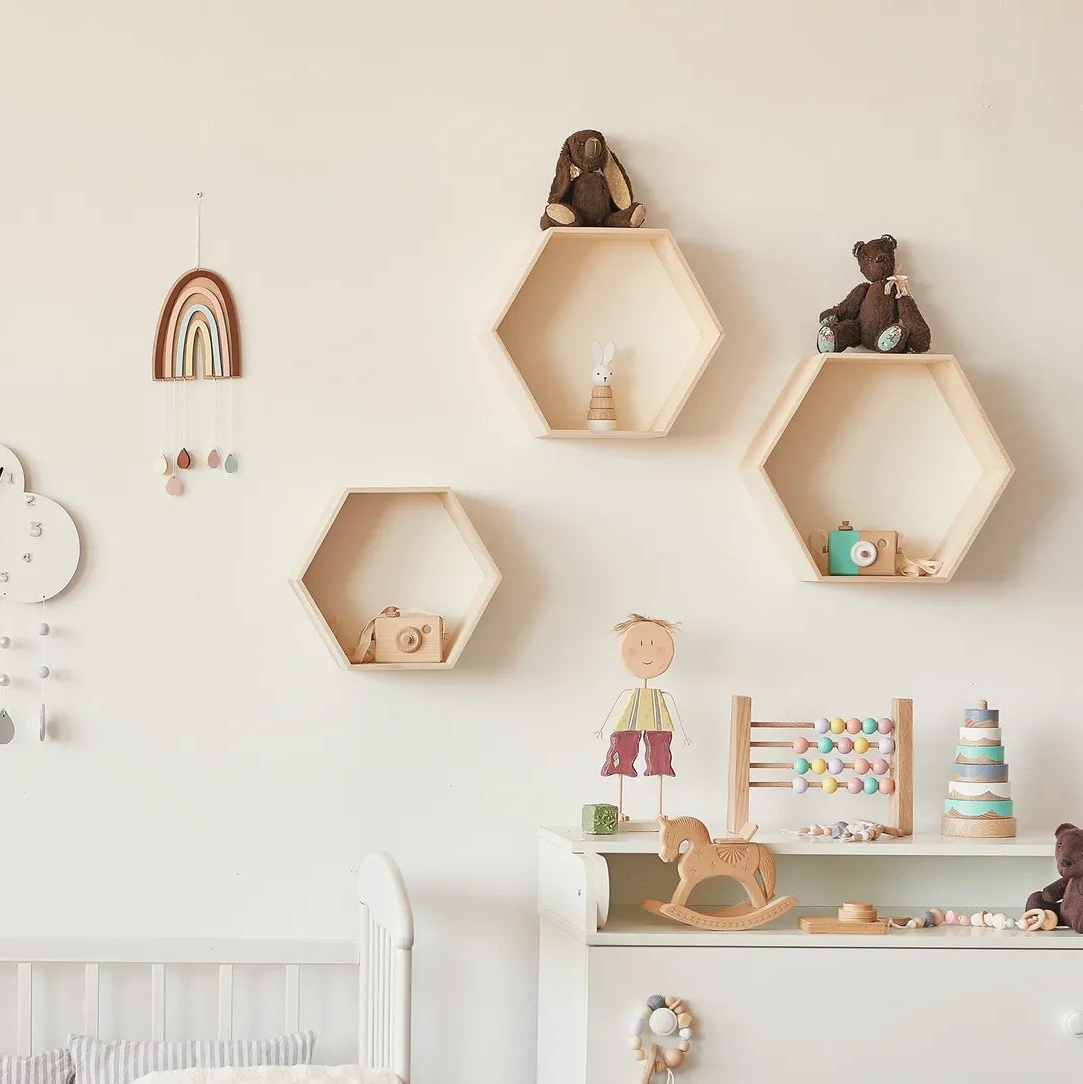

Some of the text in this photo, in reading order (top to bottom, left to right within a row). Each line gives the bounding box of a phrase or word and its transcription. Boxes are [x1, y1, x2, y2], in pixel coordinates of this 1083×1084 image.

[8, 473, 15, 484] 1
[26, 495, 35, 507] 2
[30, 522, 42, 537] 3
[22, 553, 31, 563] 4
[0, 572, 9, 583] 5
